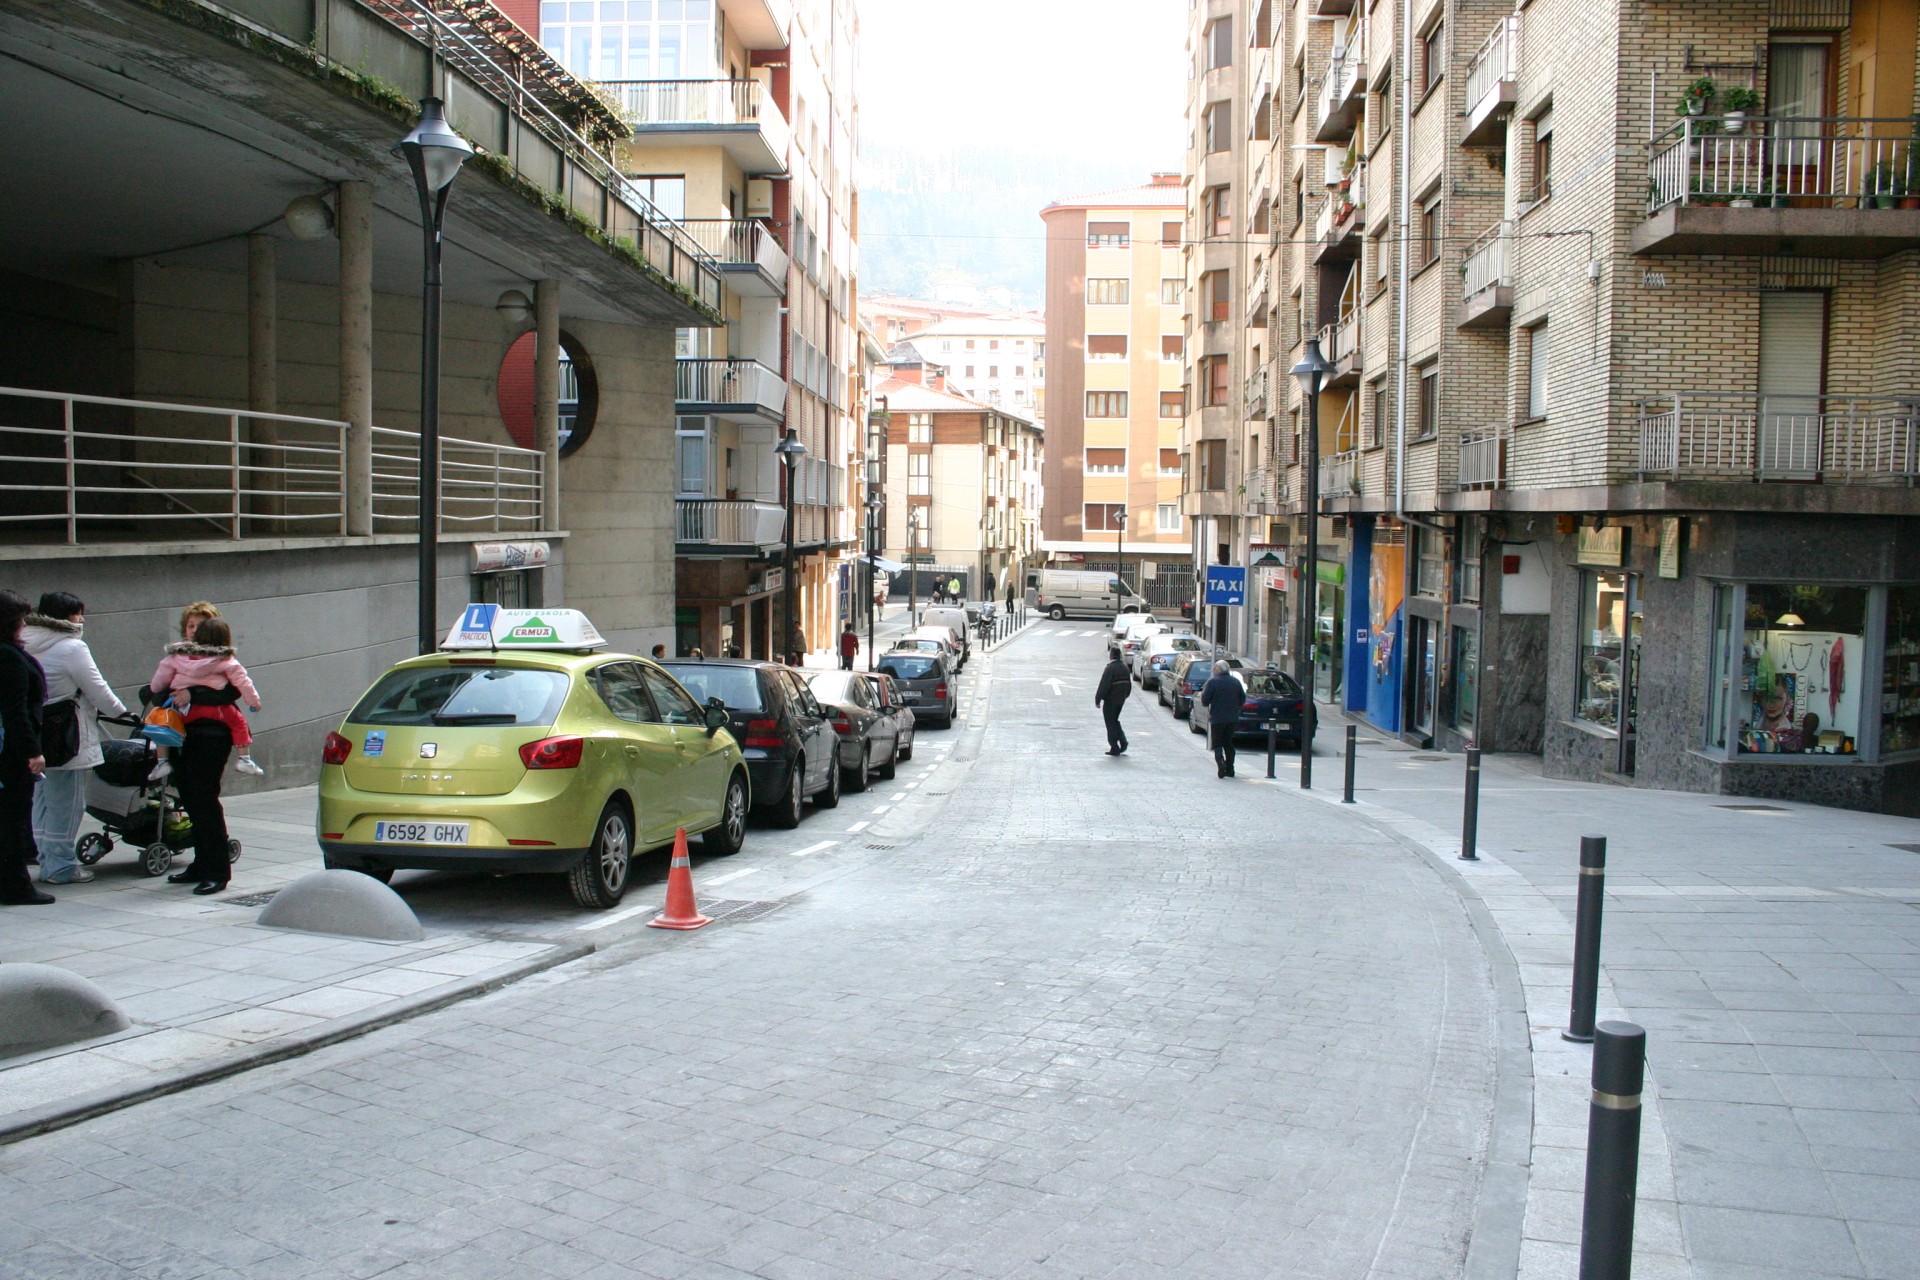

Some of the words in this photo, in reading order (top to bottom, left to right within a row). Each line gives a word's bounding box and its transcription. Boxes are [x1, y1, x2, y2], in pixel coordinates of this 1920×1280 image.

[1208, 579, 1243, 592] TAXI
[469, 608, 485, 628] L
[514, 628, 551, 637] ERMUA
[1795, 674, 1806, 727] ARTDECO
[387, 824, 427, 841] 6592
[434, 825, 464, 842] GHX
